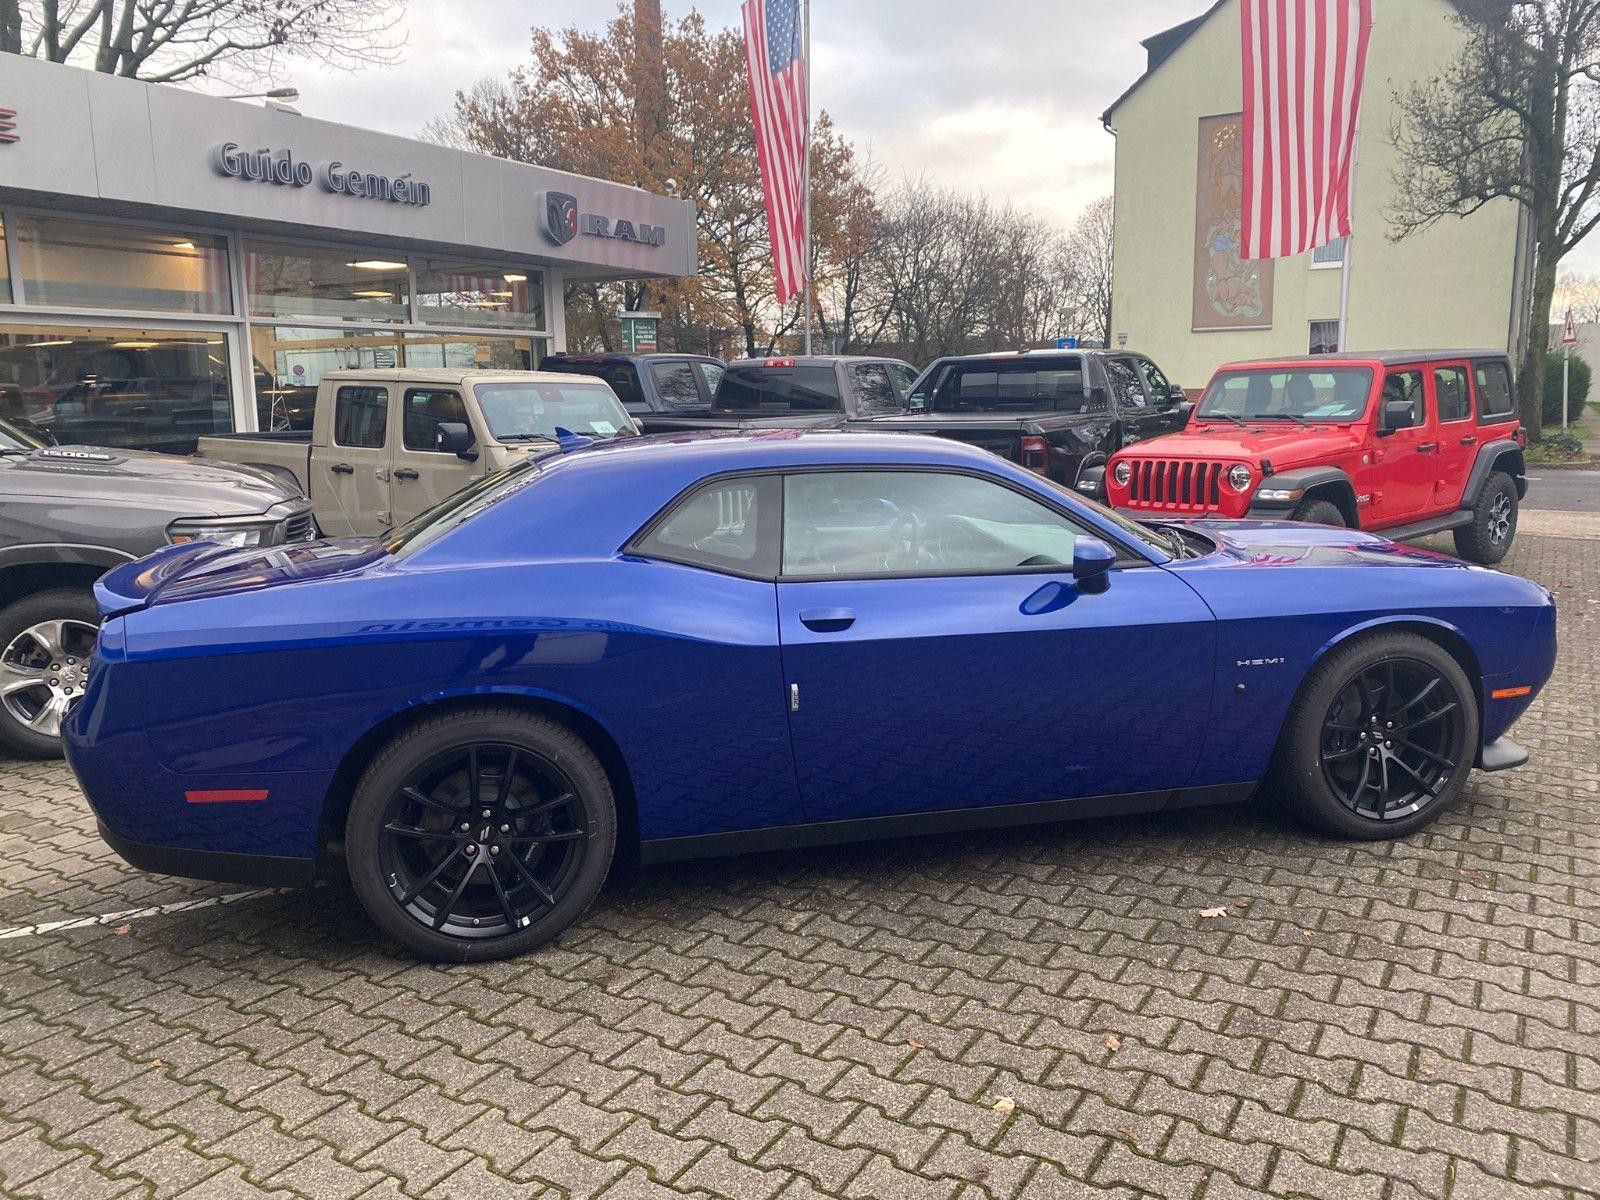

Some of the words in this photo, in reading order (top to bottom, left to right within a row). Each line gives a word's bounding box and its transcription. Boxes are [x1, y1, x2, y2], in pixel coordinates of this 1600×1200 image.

[214, 142, 313, 187] Guido
[322, 161, 431, 206] Gemein
[582, 213, 665, 247] RAM
[43, 450, 89, 459] 1500
[1236, 657, 1285, 666] HEMI
